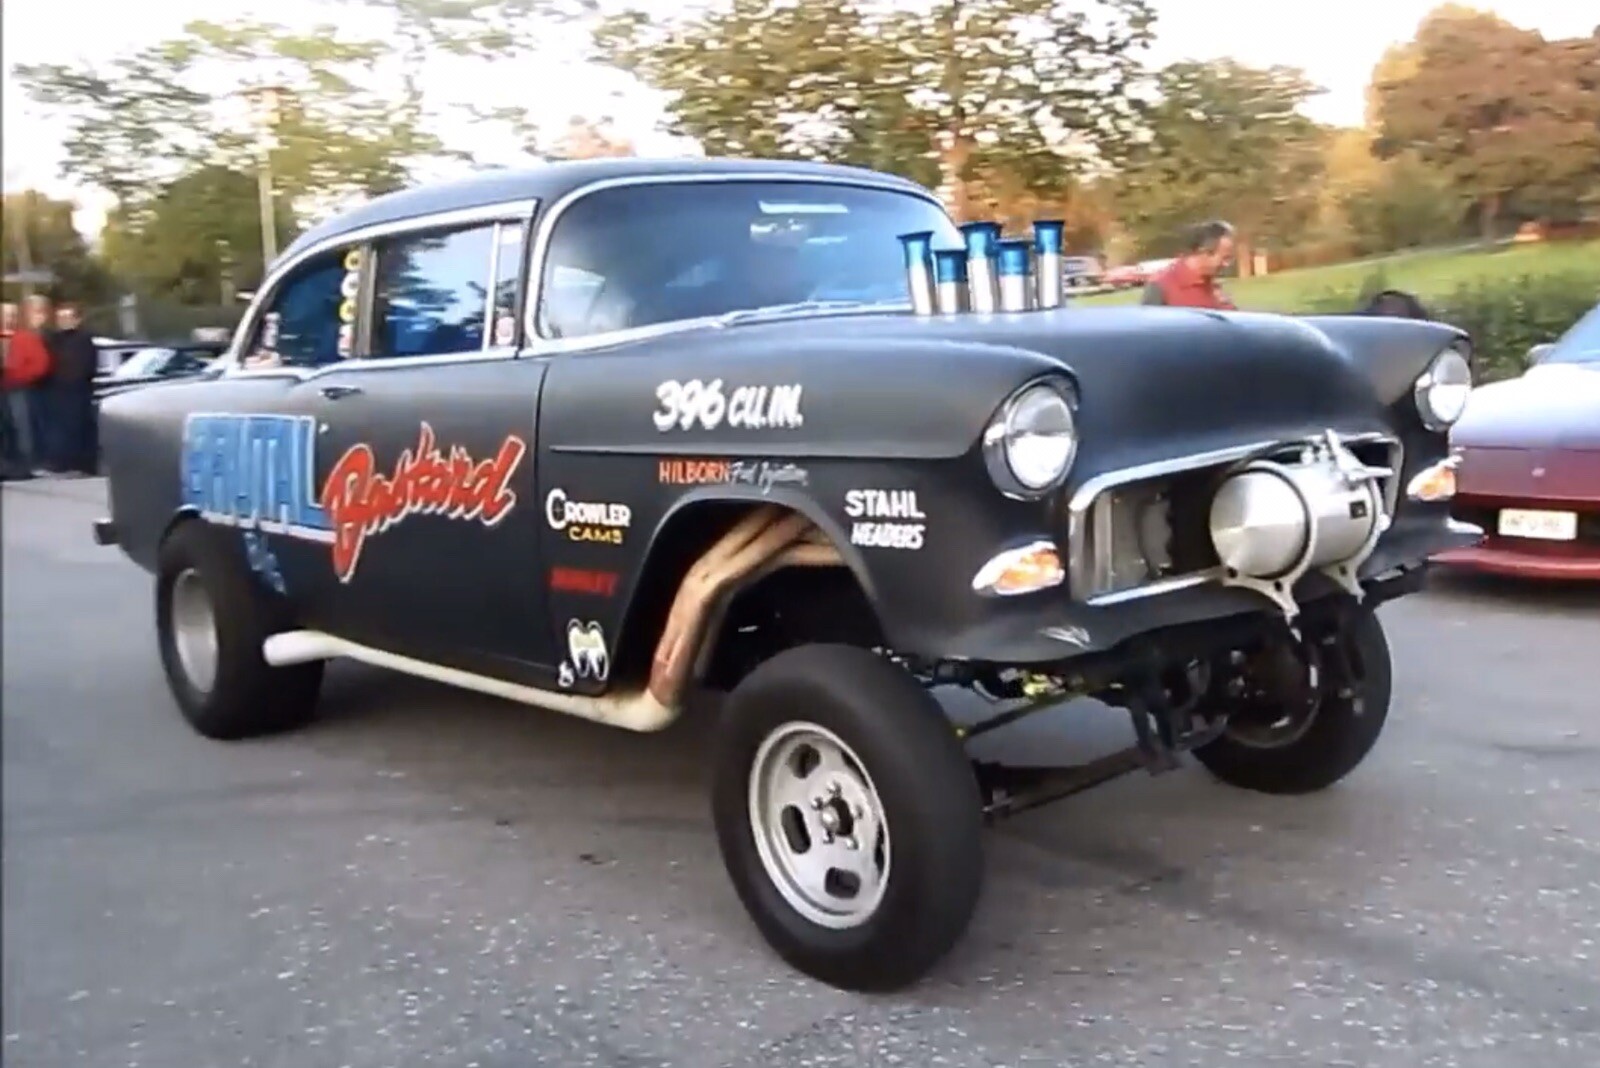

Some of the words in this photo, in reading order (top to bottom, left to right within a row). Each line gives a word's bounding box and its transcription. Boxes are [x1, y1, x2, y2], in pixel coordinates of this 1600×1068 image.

[653, 378, 726, 432] 396
[658, 460, 730, 484] HILBORN
[844, 489, 926, 519] STAHL
[569, 526, 623, 544] CAMS
[850, 521, 926, 550] HEADERS
